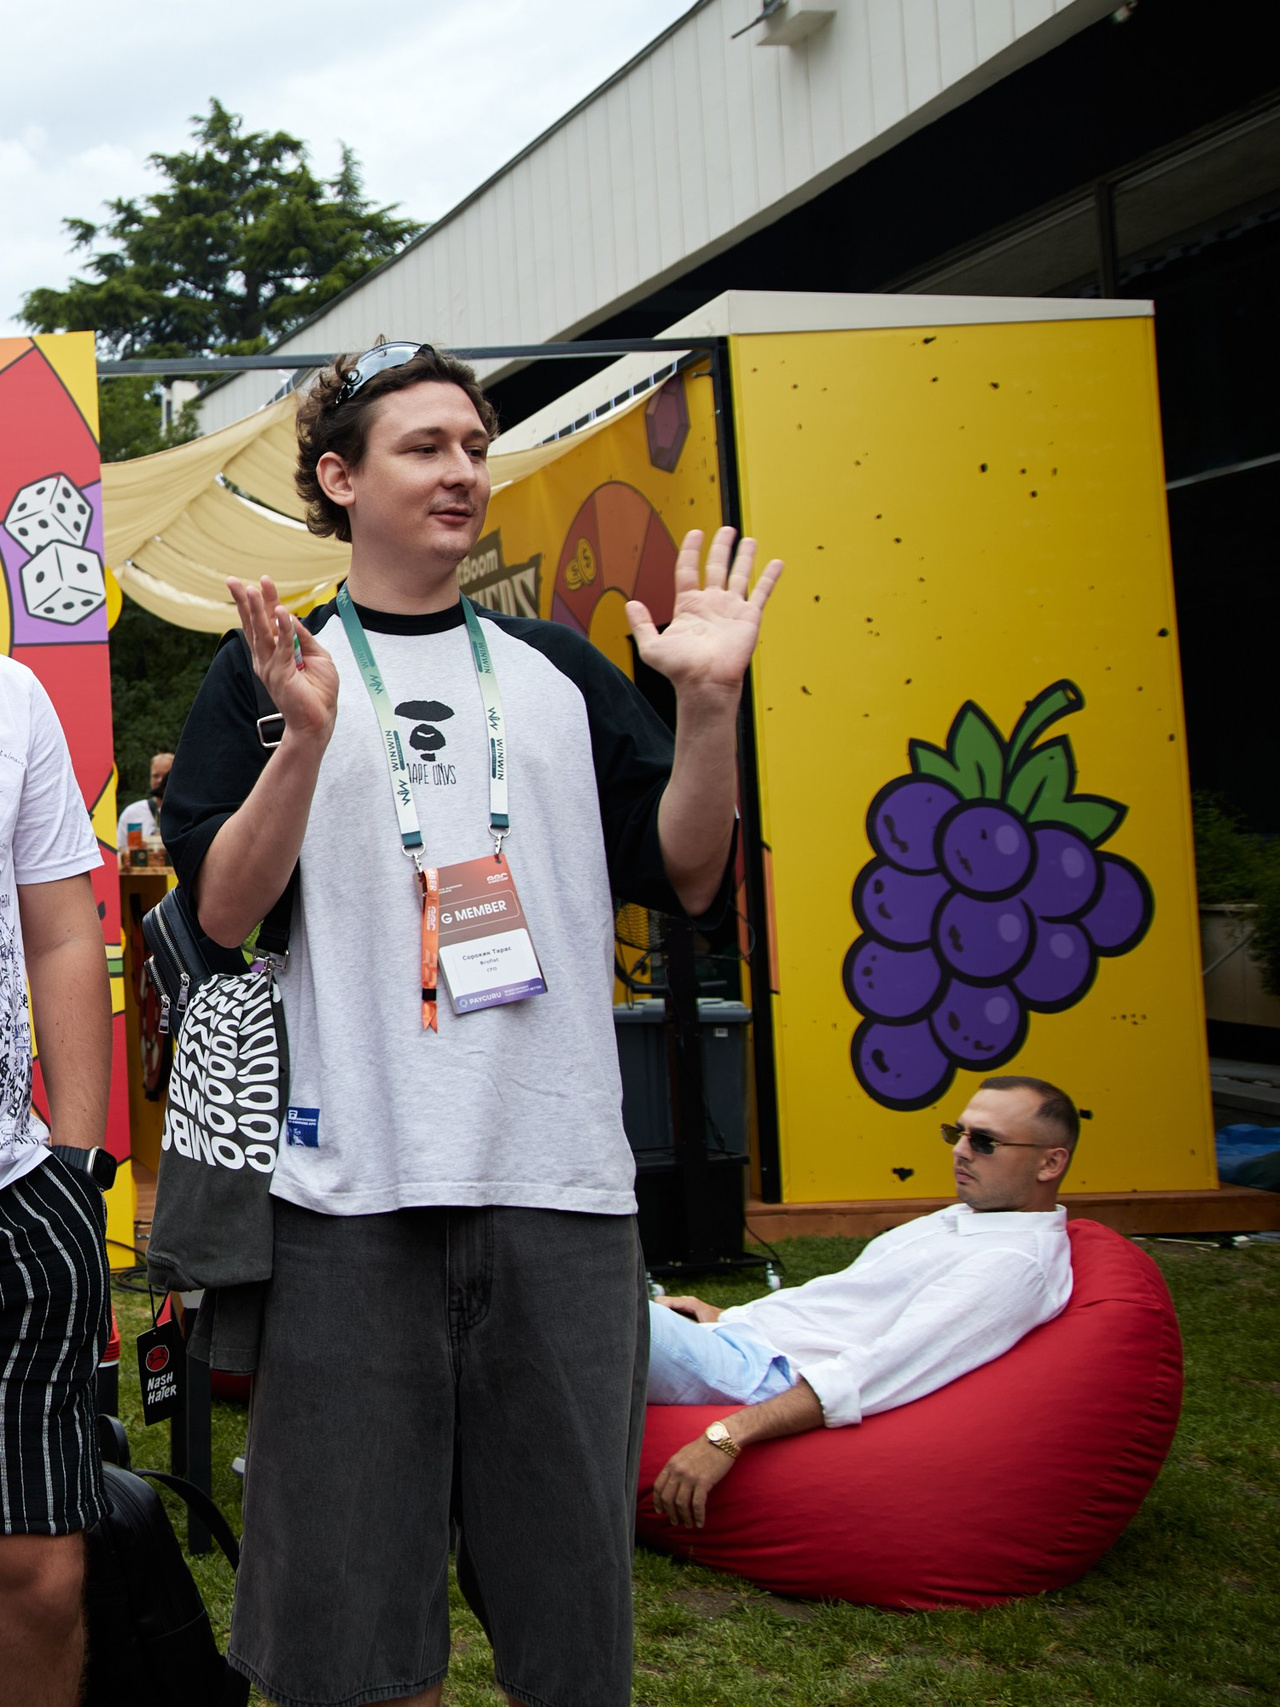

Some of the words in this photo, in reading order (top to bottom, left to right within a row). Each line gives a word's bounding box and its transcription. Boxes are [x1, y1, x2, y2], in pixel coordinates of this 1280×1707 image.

[478, 642, 491, 674] WINWIN
[384, 730, 400, 772] WINWIN
[496, 738, 505, 781] WINWIN
[441, 912, 453, 924] G
[454, 900, 507, 922] MEMBER
[469, 992, 502, 1005] PAYGURU
